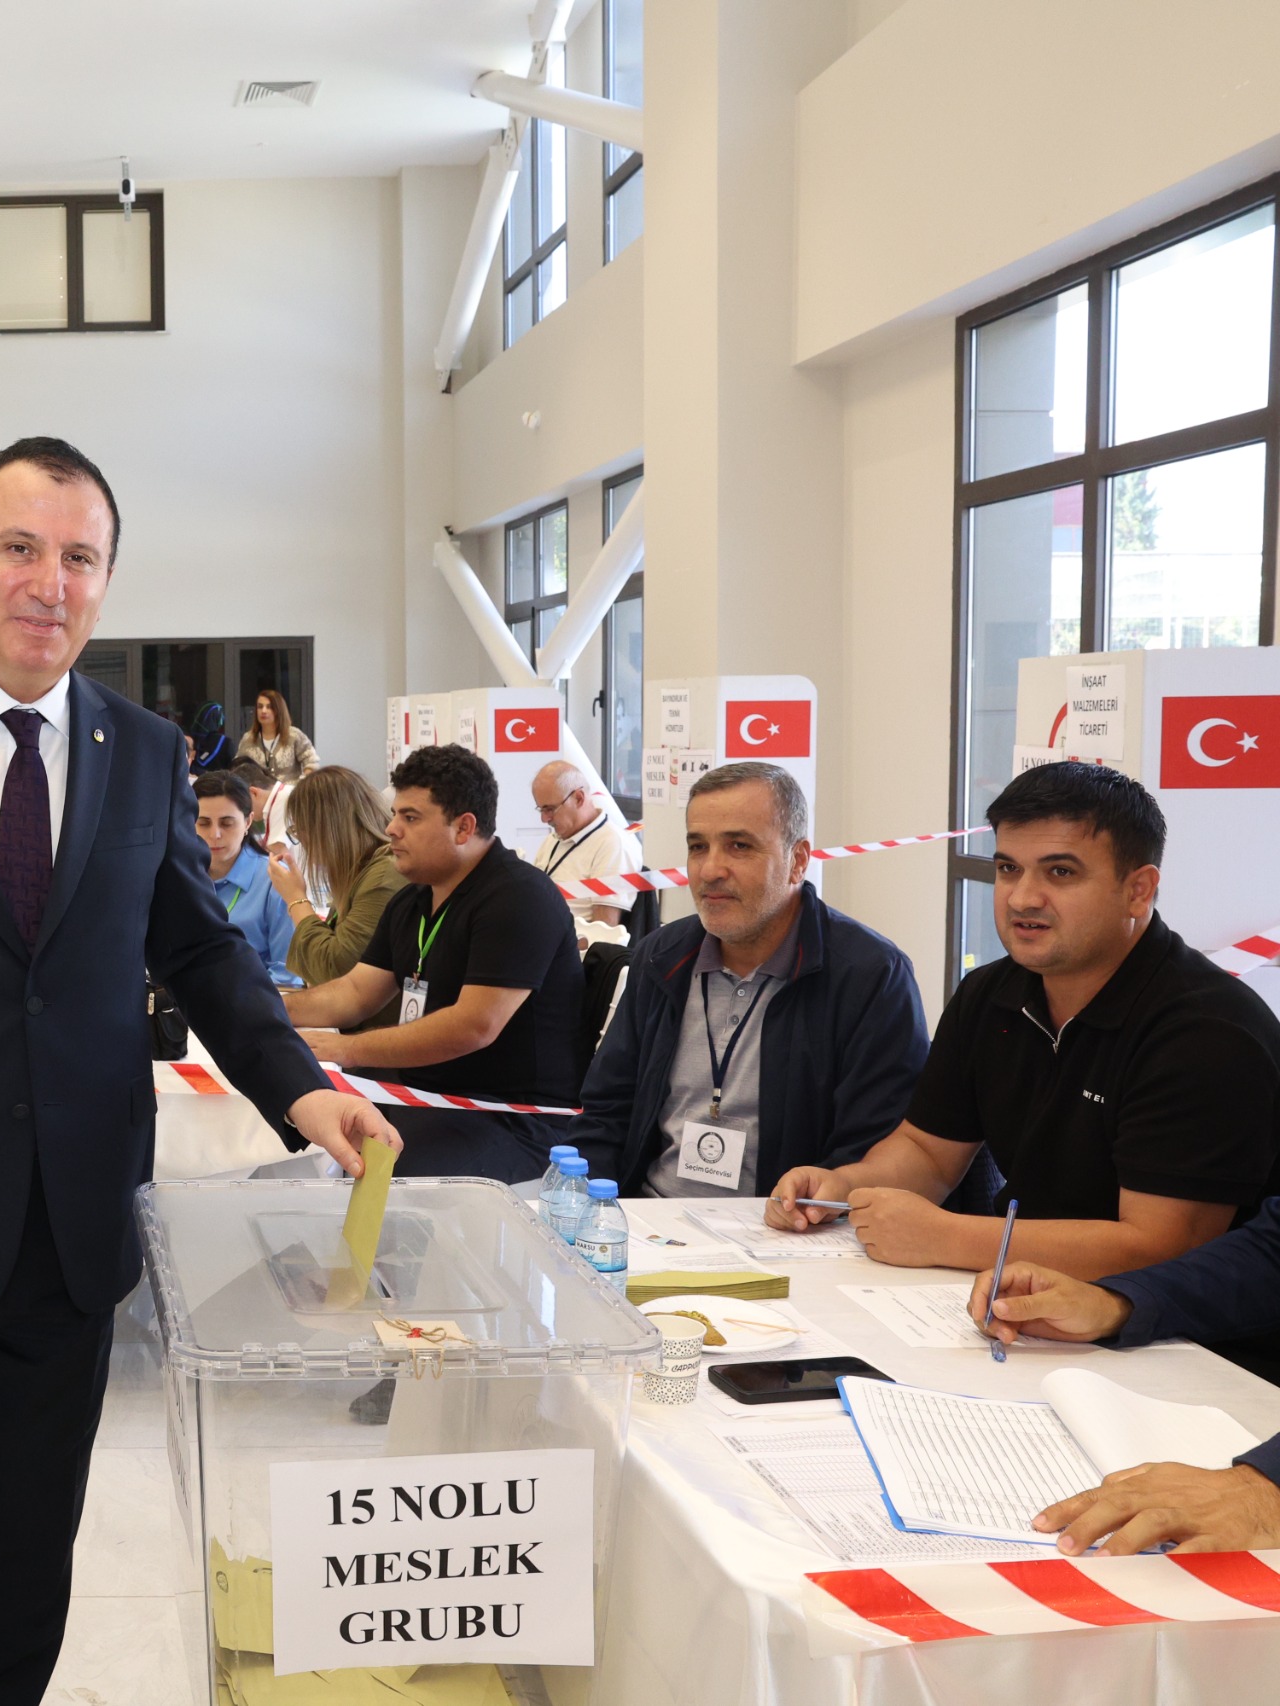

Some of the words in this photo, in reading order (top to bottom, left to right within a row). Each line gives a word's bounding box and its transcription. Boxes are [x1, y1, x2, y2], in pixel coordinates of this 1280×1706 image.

[1081, 673, 1107, 690] İNŞAAT
[1072, 696, 1118, 712] MALZEMELERİ
[1079, 721, 1108, 736] TİCARETİ
[684, 1163, 704, 1173] Seçim
[704, 1167, 733, 1178] Görevlisi
[326, 1488, 376, 1526] 15
[389, 1477, 540, 1522] NOLU
[321, 1541, 545, 1589] MESLEK
[339, 1602, 525, 1645] GRUBU
